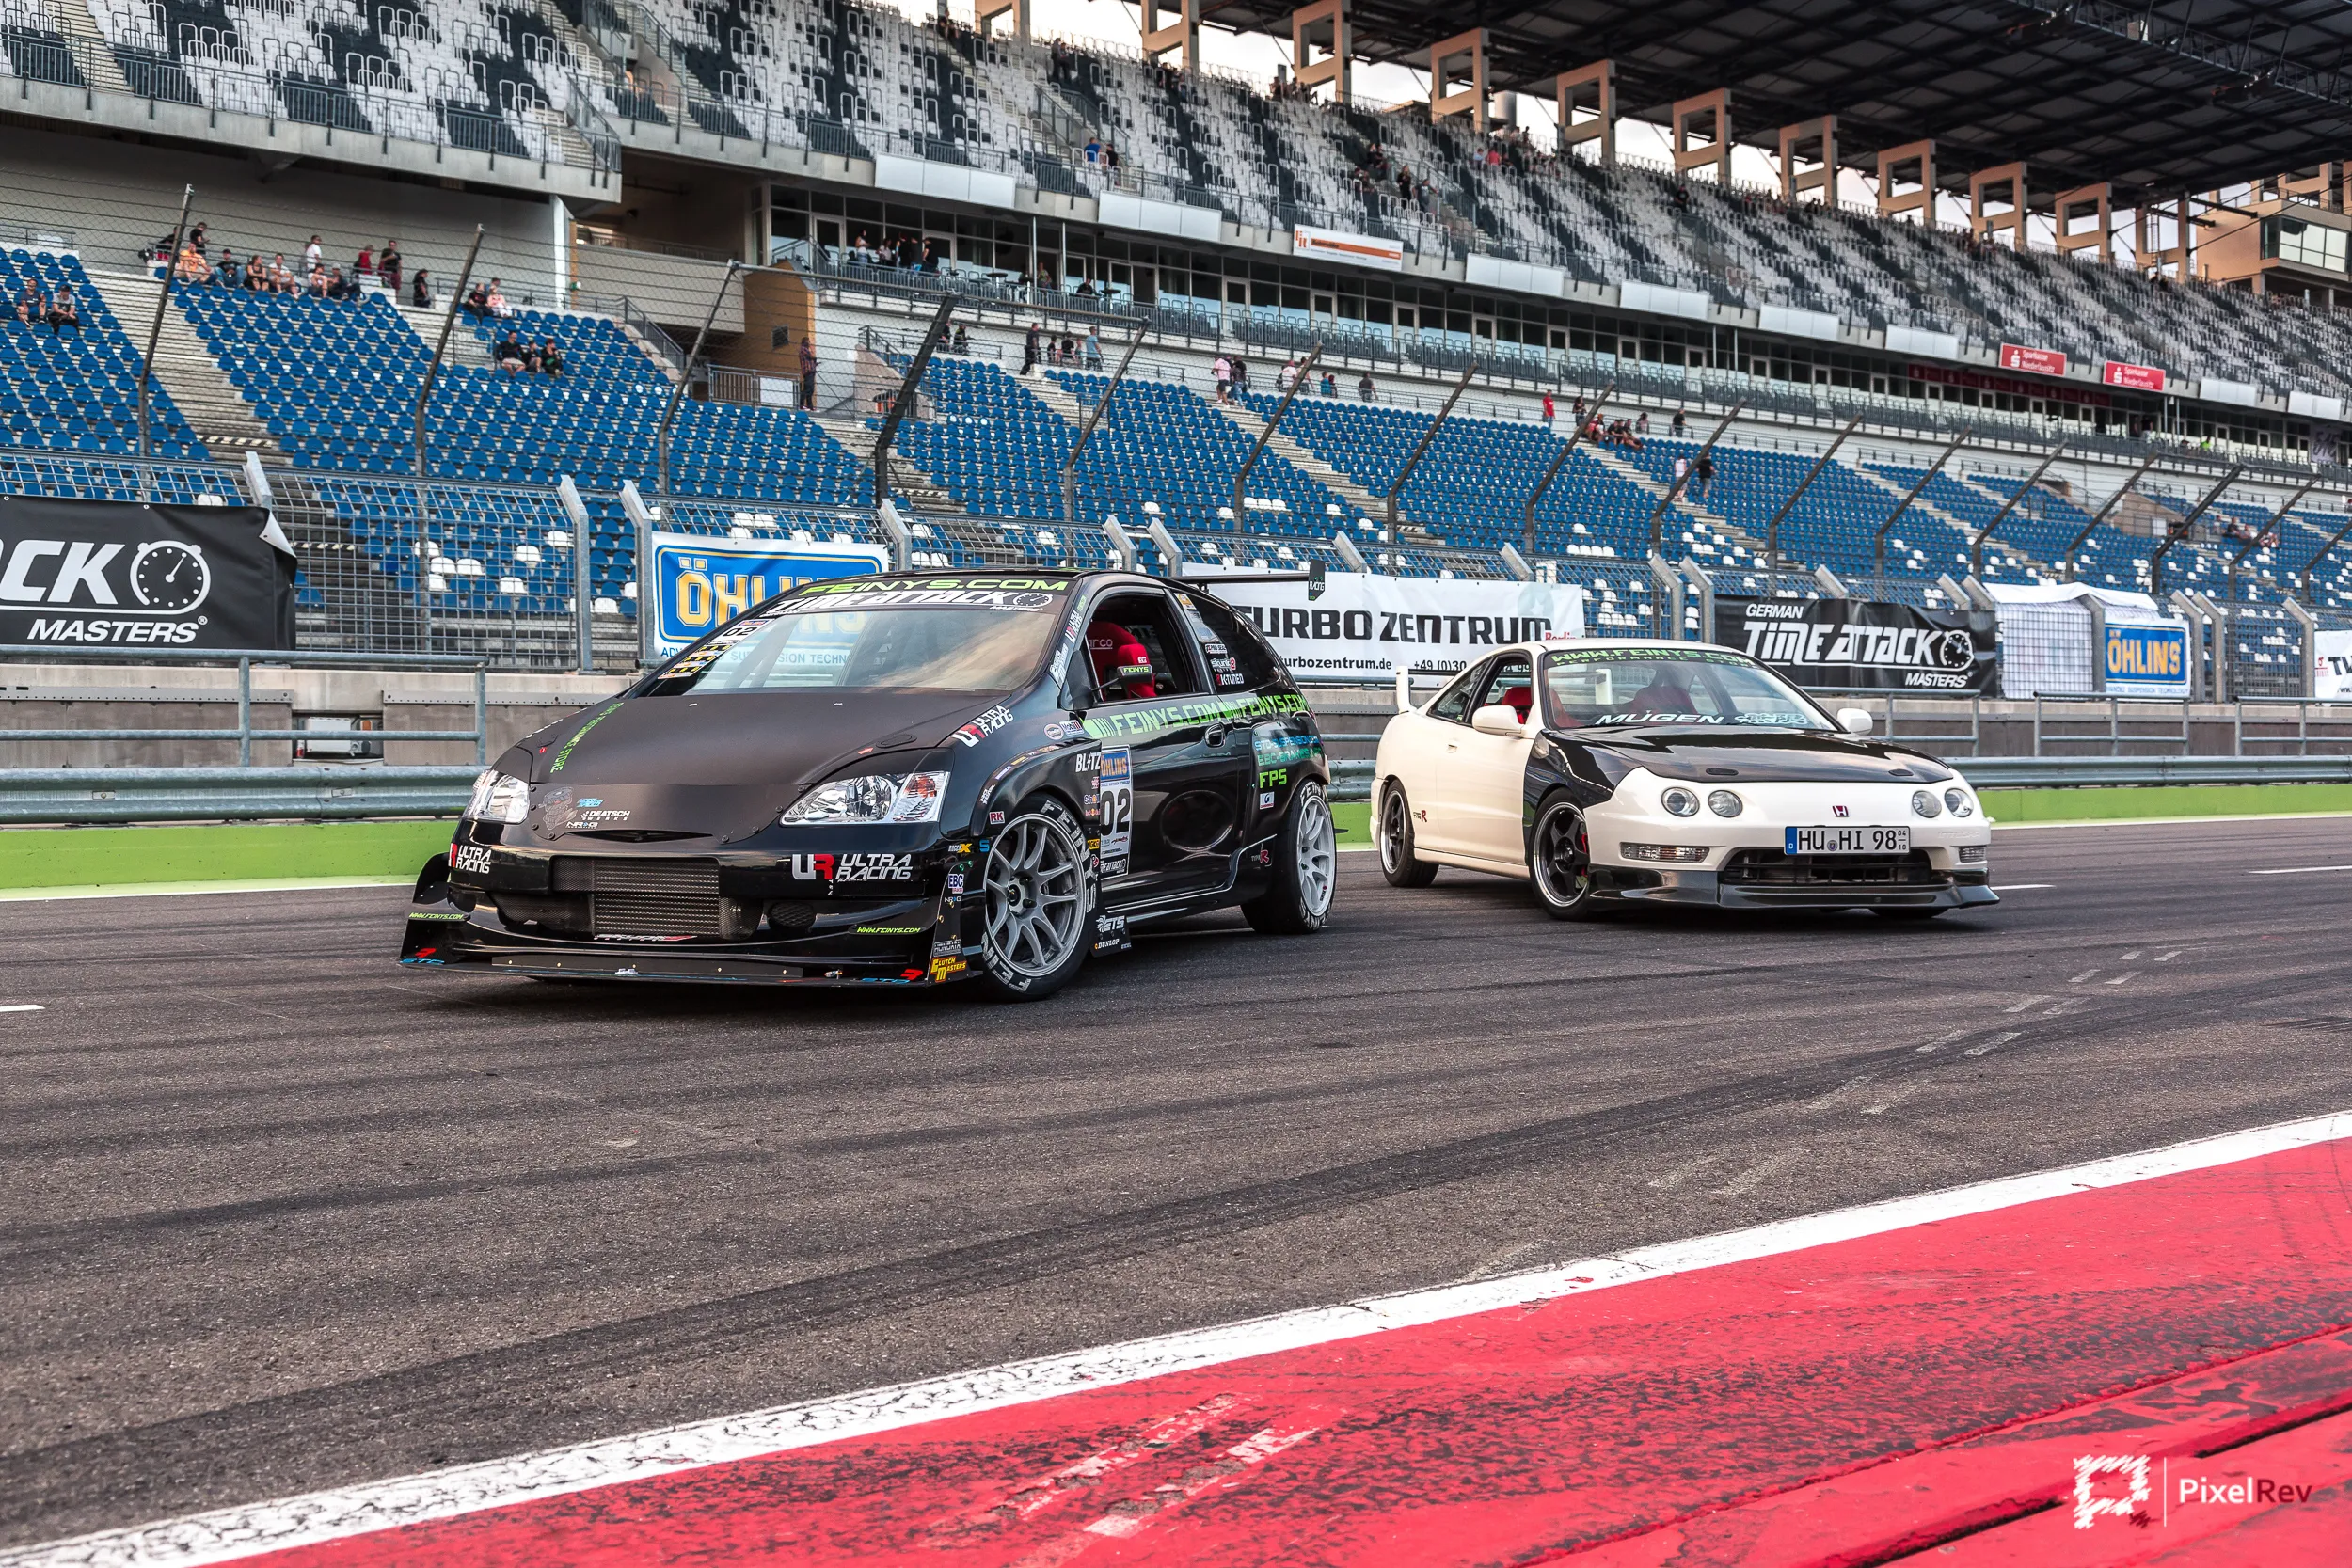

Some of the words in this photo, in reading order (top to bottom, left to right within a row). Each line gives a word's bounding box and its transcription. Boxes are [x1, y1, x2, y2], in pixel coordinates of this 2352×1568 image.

[0, 539, 125, 604] CK
[798, 578, 1070, 596] FEINYS.COM
[1745, 604, 1804, 619] GERMAN
[27, 618, 199, 643] MASTERS
[1380, 612, 1552, 645] ZENTRUM
[1825, 624, 1942, 665] ATTACK
[2108, 629, 2182, 675] ÖHLINS
[1414, 659, 1434, 671] +49
[1437, 659, 1468, 672] (0)30
[1905, 673, 1969, 688] MASTERS
[972, 705, 1010, 726] ULTRA
[980, 712, 1013, 736] RACING
[1109, 700, 1222, 738] FEINYS.COM
[1259, 768, 1287, 789] FPS
[990, 812, 1004, 821] RK
[1100, 788, 1130, 836] 02
[1798, 830, 1825, 850] HU
[1838, 830, 1865, 850] HI
[1872, 830, 1897, 850] 98
[458, 845, 492, 861] ULTRA
[840, 853, 912, 866] ULTRA
[1260, 849, 1270, 863] R
[455, 857, 491, 874] RACING
[834, 866, 914, 879] RACING
[948, 874, 963, 888] EBC
[1098, 939, 1120, 949] DUNLOP
[931, 957, 956, 973] CLUTCH
[936, 963, 967, 980] MASTERS
